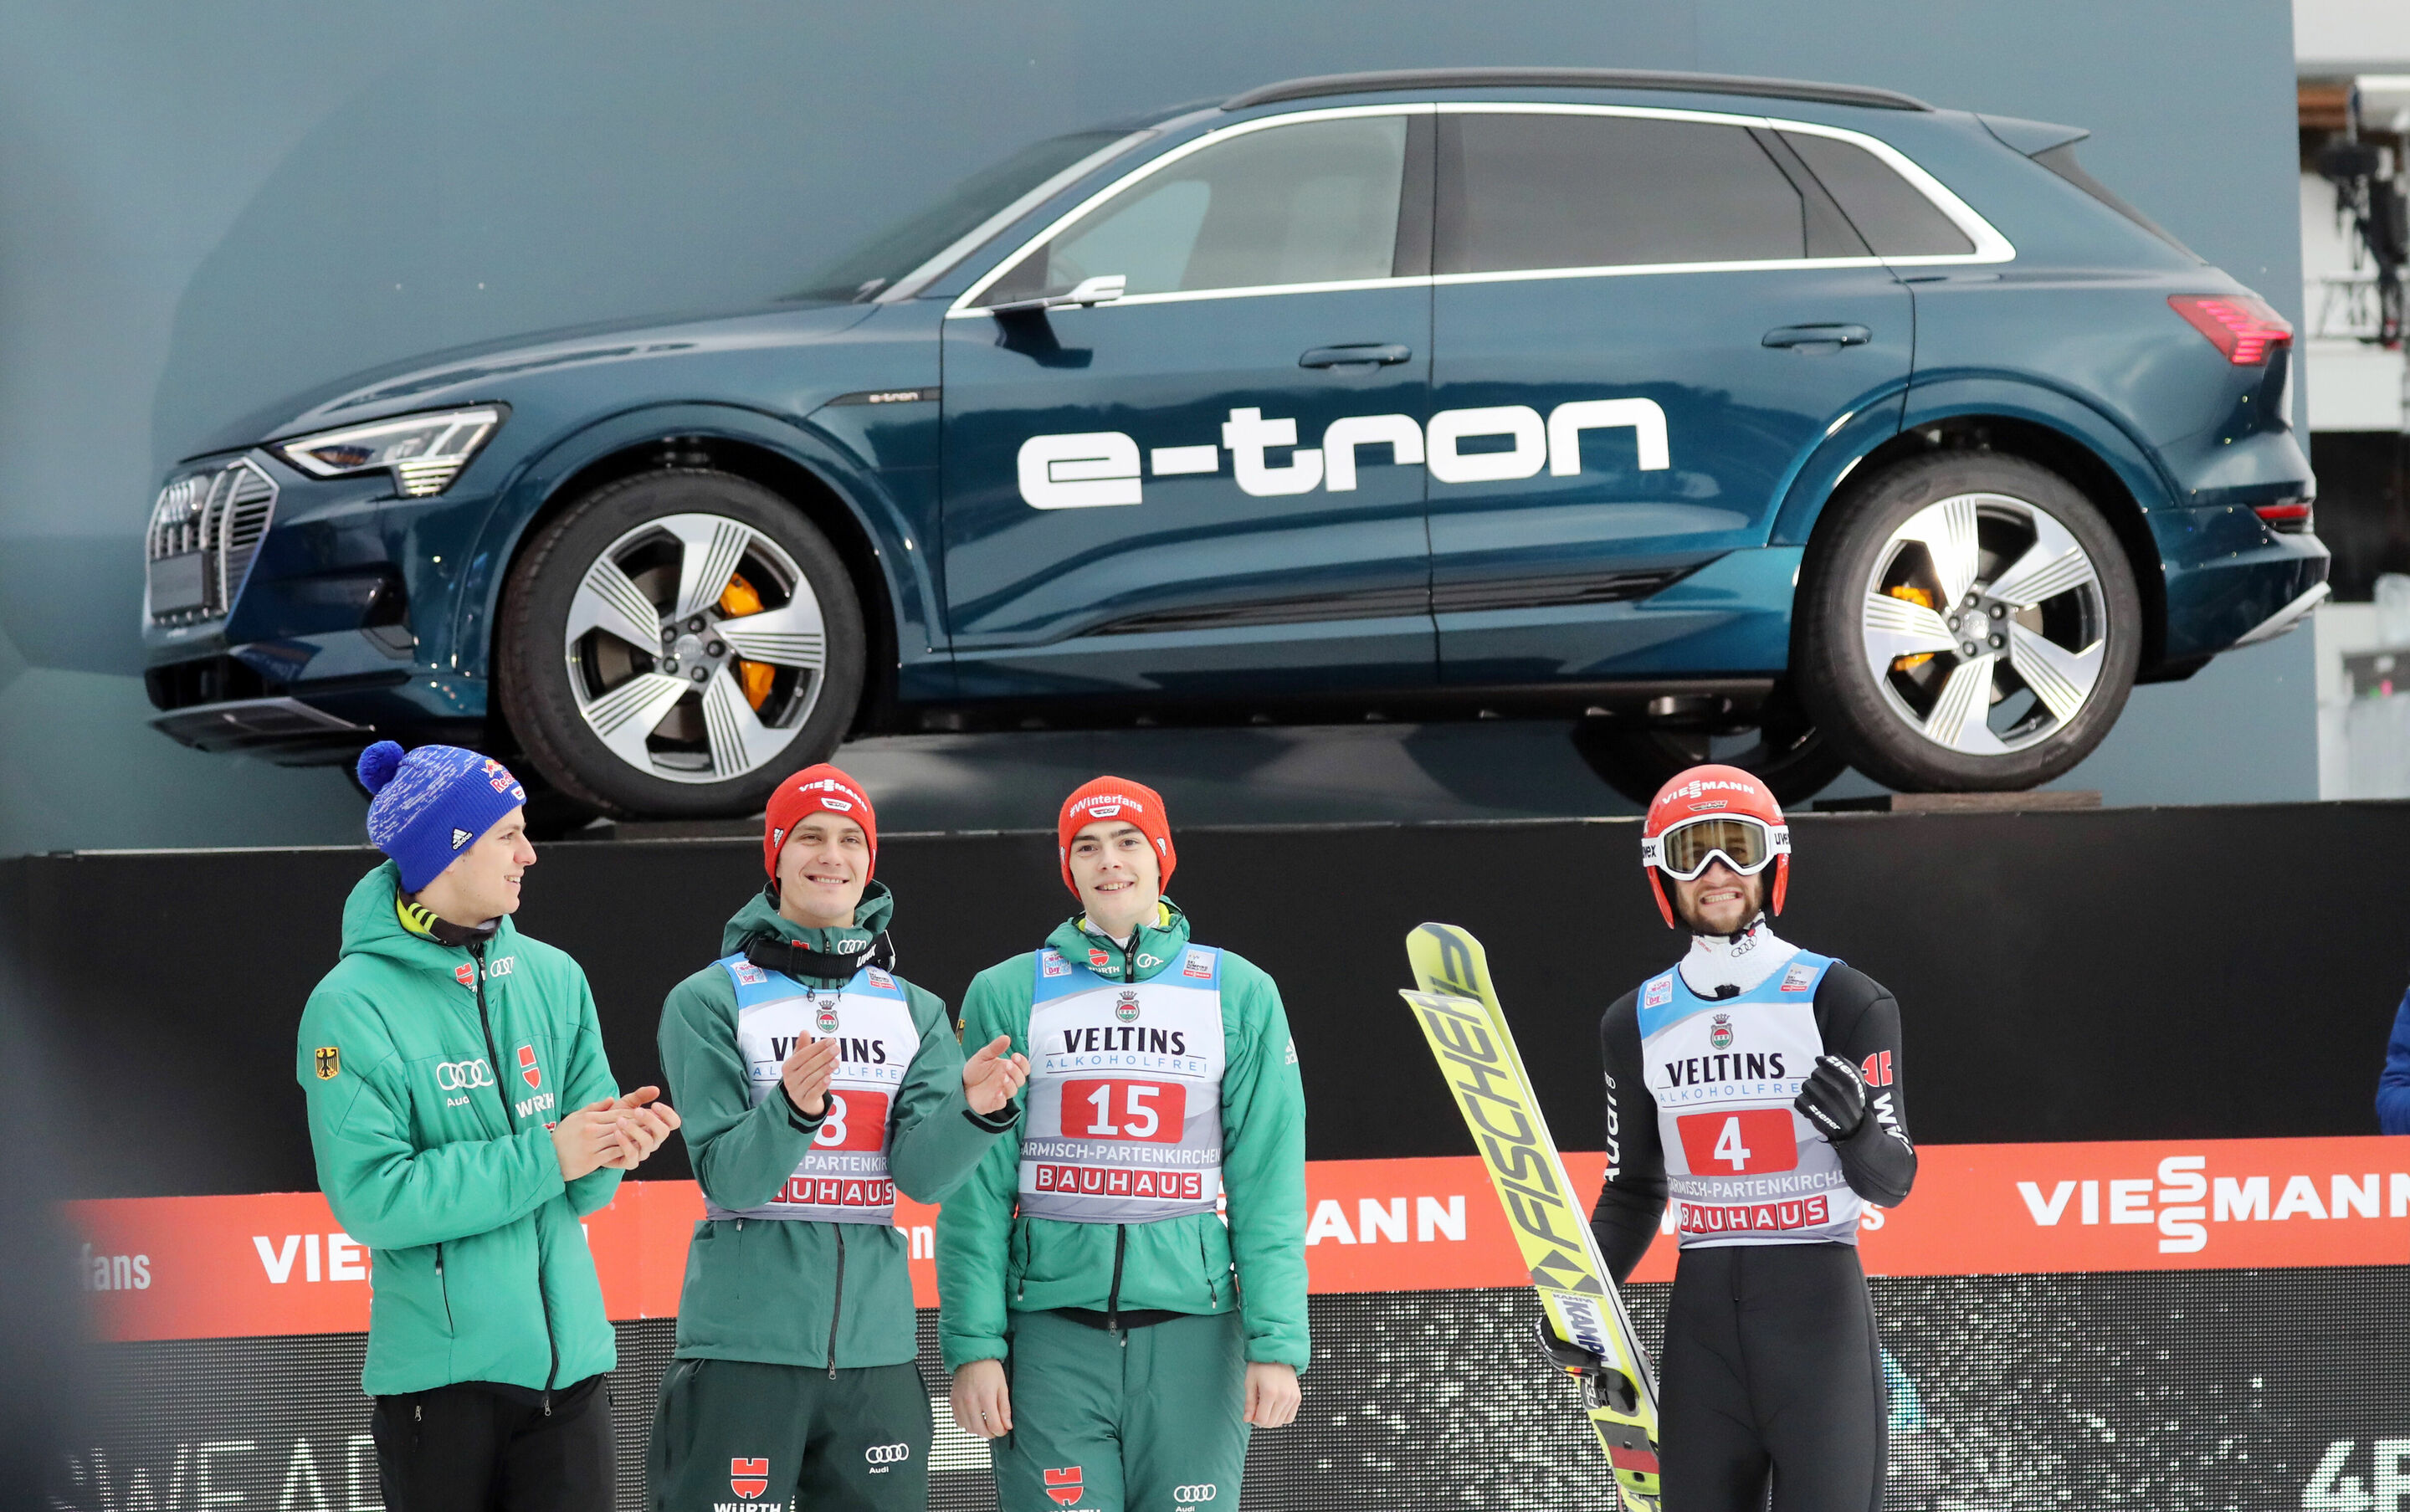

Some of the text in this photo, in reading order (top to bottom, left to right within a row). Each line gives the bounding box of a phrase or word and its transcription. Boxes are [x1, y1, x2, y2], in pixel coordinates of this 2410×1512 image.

[869, 392, 919, 403] e-tron
[1017, 397, 1669, 510] e-tron
[799, 779, 868, 812] VIESSMANN
[1662, 780, 1755, 804] VIESSMANN
[1069, 794, 1144, 818] #Winterfans
[1643, 844, 1656, 859] vex
[1774, 833, 1789, 845] uve
[772, 1037, 886, 1064] VINS
[1063, 1026, 1186, 1056] VELTINS
[1046, 1055, 1207, 1073] ALKOHOLFREI
[1665, 1053, 1785, 1088] VELTINS
[1660, 1083, 1800, 1102] ALKOHOLFRE
[813, 1094, 848, 1147] 8
[1087, 1084, 1160, 1138] 15
[1808, 1105, 1841, 1130] ziener
[1714, 1116, 1751, 1171] 4
[1038, 1168, 1199, 1195] BAUHAUS
[1680, 1198, 1826, 1230] BAUHAUS
[869, 1466, 890, 1474] Audi
